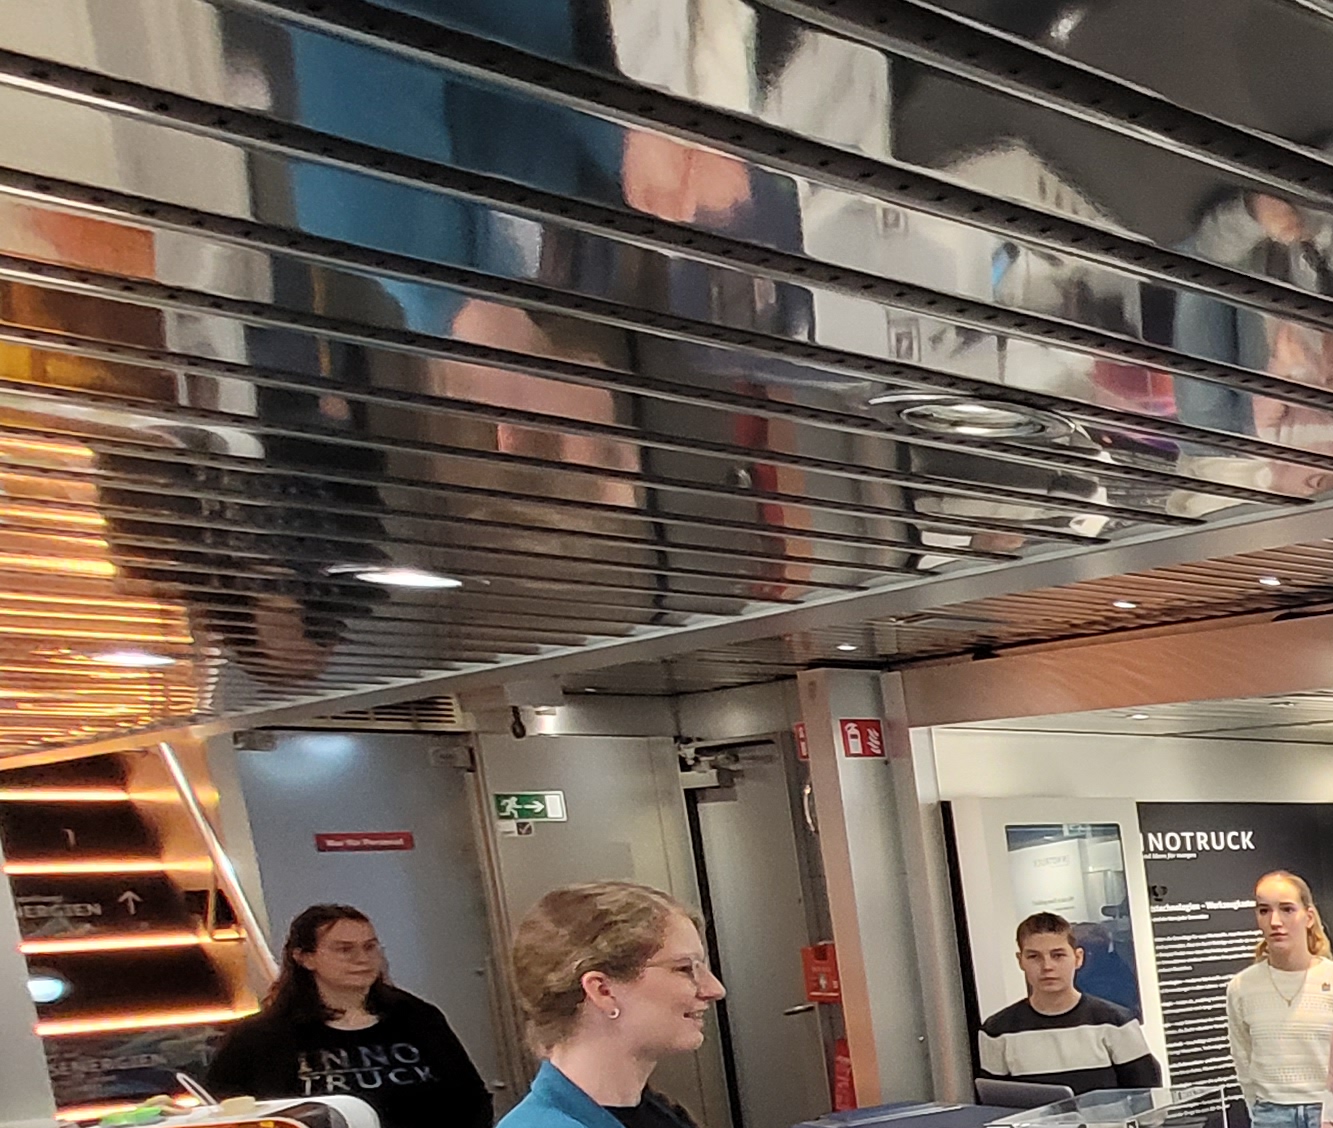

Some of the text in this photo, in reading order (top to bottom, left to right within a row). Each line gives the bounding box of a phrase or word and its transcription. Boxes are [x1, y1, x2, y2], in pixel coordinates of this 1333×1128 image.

[1140, 830, 1256, 852] NOTRUCK
[298, 1042, 420, 1073] INNO
[298, 1066, 440, 1096] TRUCK
